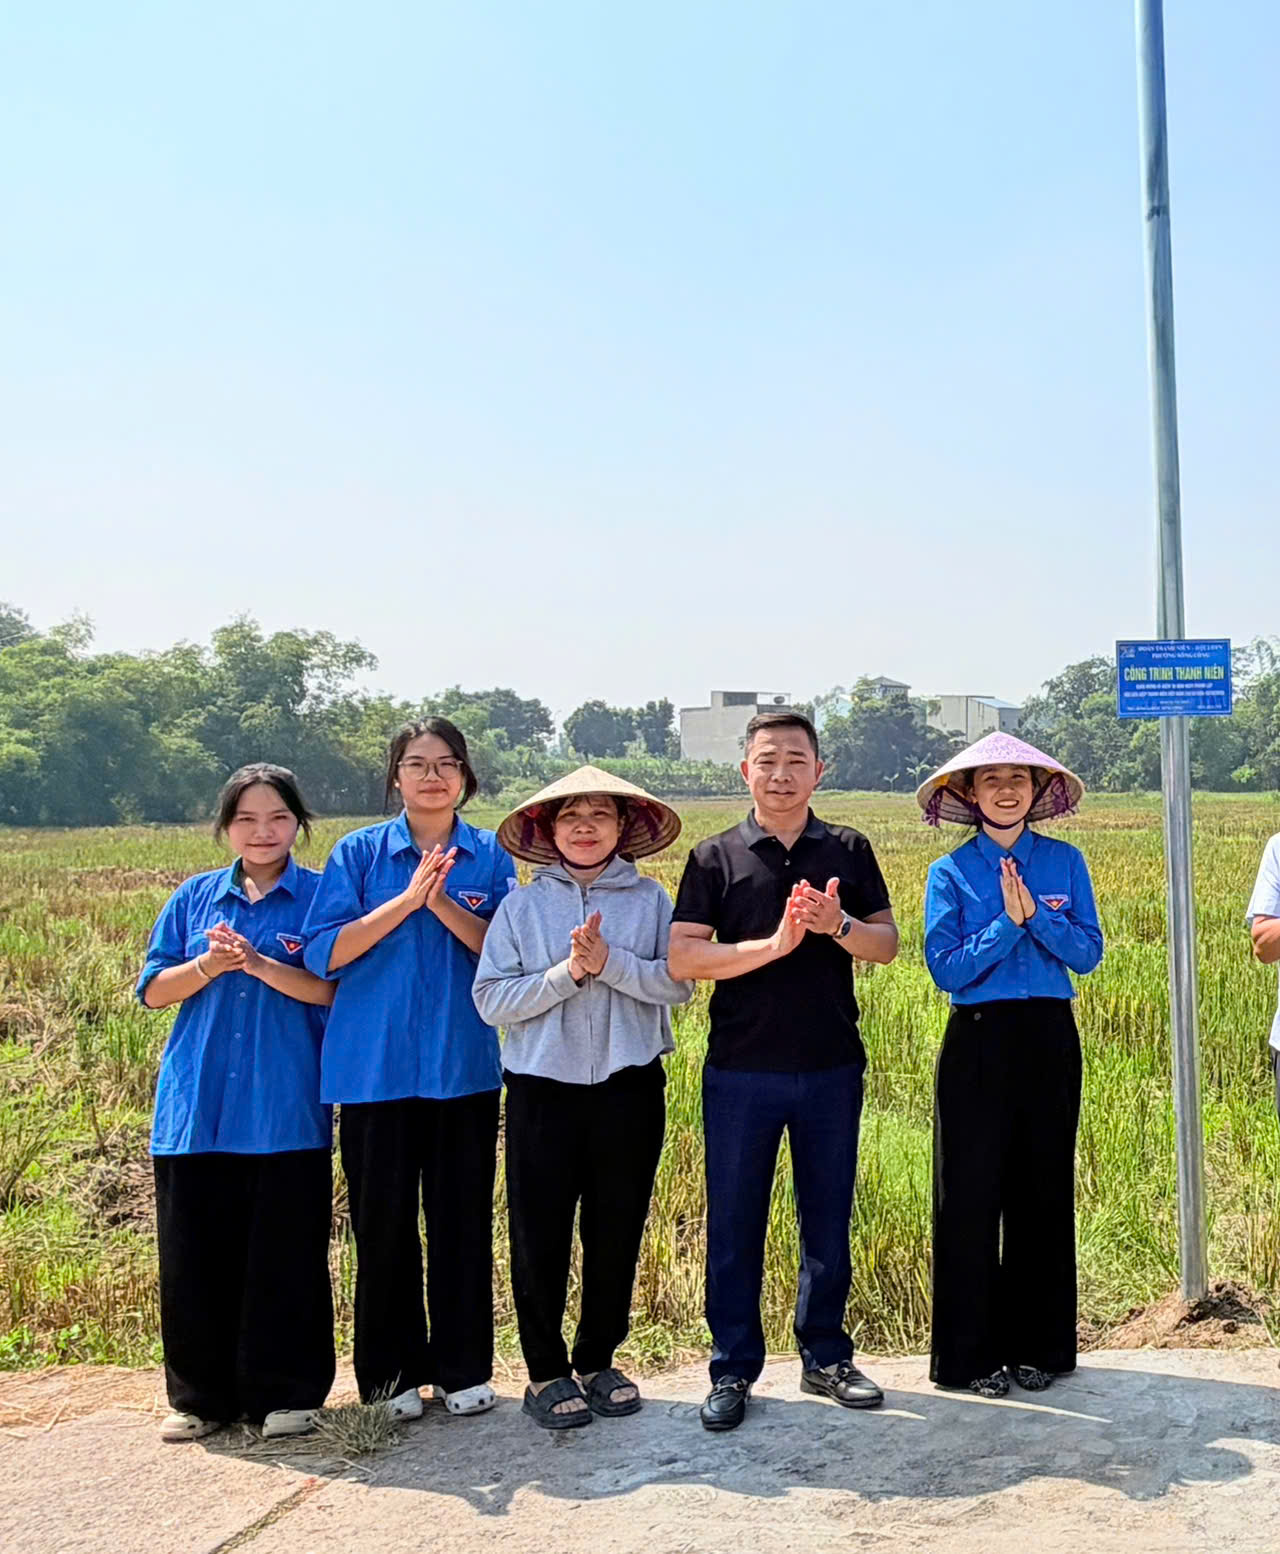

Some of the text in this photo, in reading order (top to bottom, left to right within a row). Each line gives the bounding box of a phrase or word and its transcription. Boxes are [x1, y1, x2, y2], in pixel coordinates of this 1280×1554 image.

[1124, 663, 1225, 681] CÔNG TRÌNH THANH NIÊN
